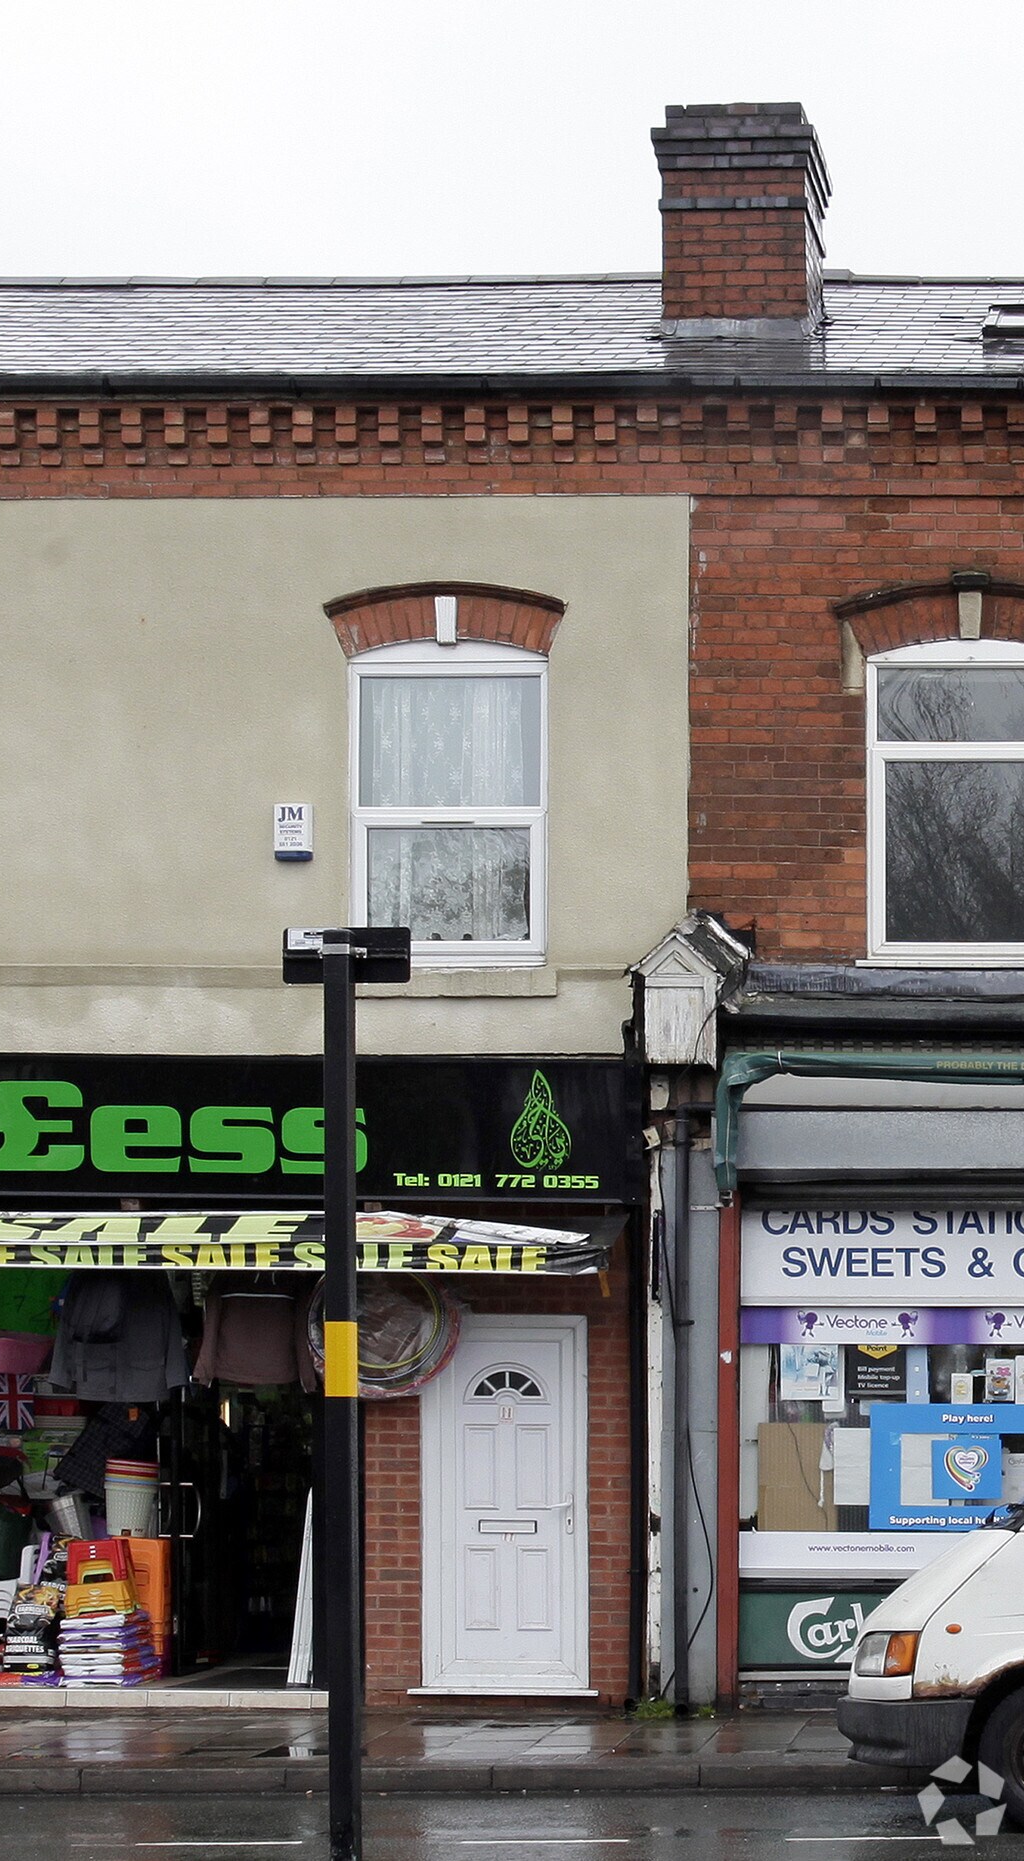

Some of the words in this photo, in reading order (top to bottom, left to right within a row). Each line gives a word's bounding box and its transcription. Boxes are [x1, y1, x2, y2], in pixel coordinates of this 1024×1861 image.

[278, 807, 304, 822] JM
[936, 1061, 994, 1070] PROBABLY
[997, 1062, 1018, 1070] THE
[393, 1173, 430, 1187] Tel:
[438, 1174, 482, 1188] 0121
[495, 1174, 536, 1188] 772
[543, 1175, 600, 1189] 0355
[761, 1210, 896, 1236] CARDS
[29, 1243, 148, 1267] SALE
[161, 1242, 280, 1269] SALE
[293, 1242, 413, 1271] SLE
[426, 1243, 547, 1273] SALE
[782, 1247, 947, 1278] SWEETS
[967, 1247, 995, 1278] &
[826, 1314, 888, 1329] Vectone
[868, 1366, 895, 1374] payment
[942, 1414, 965, 1424] Play
[967, 1414, 993, 1422] here!
[889, 1515, 947, 1526] Supporting
[948, 1515, 973, 1524] local
[808, 1543, 915, 1553] www.vectonemobile.com
